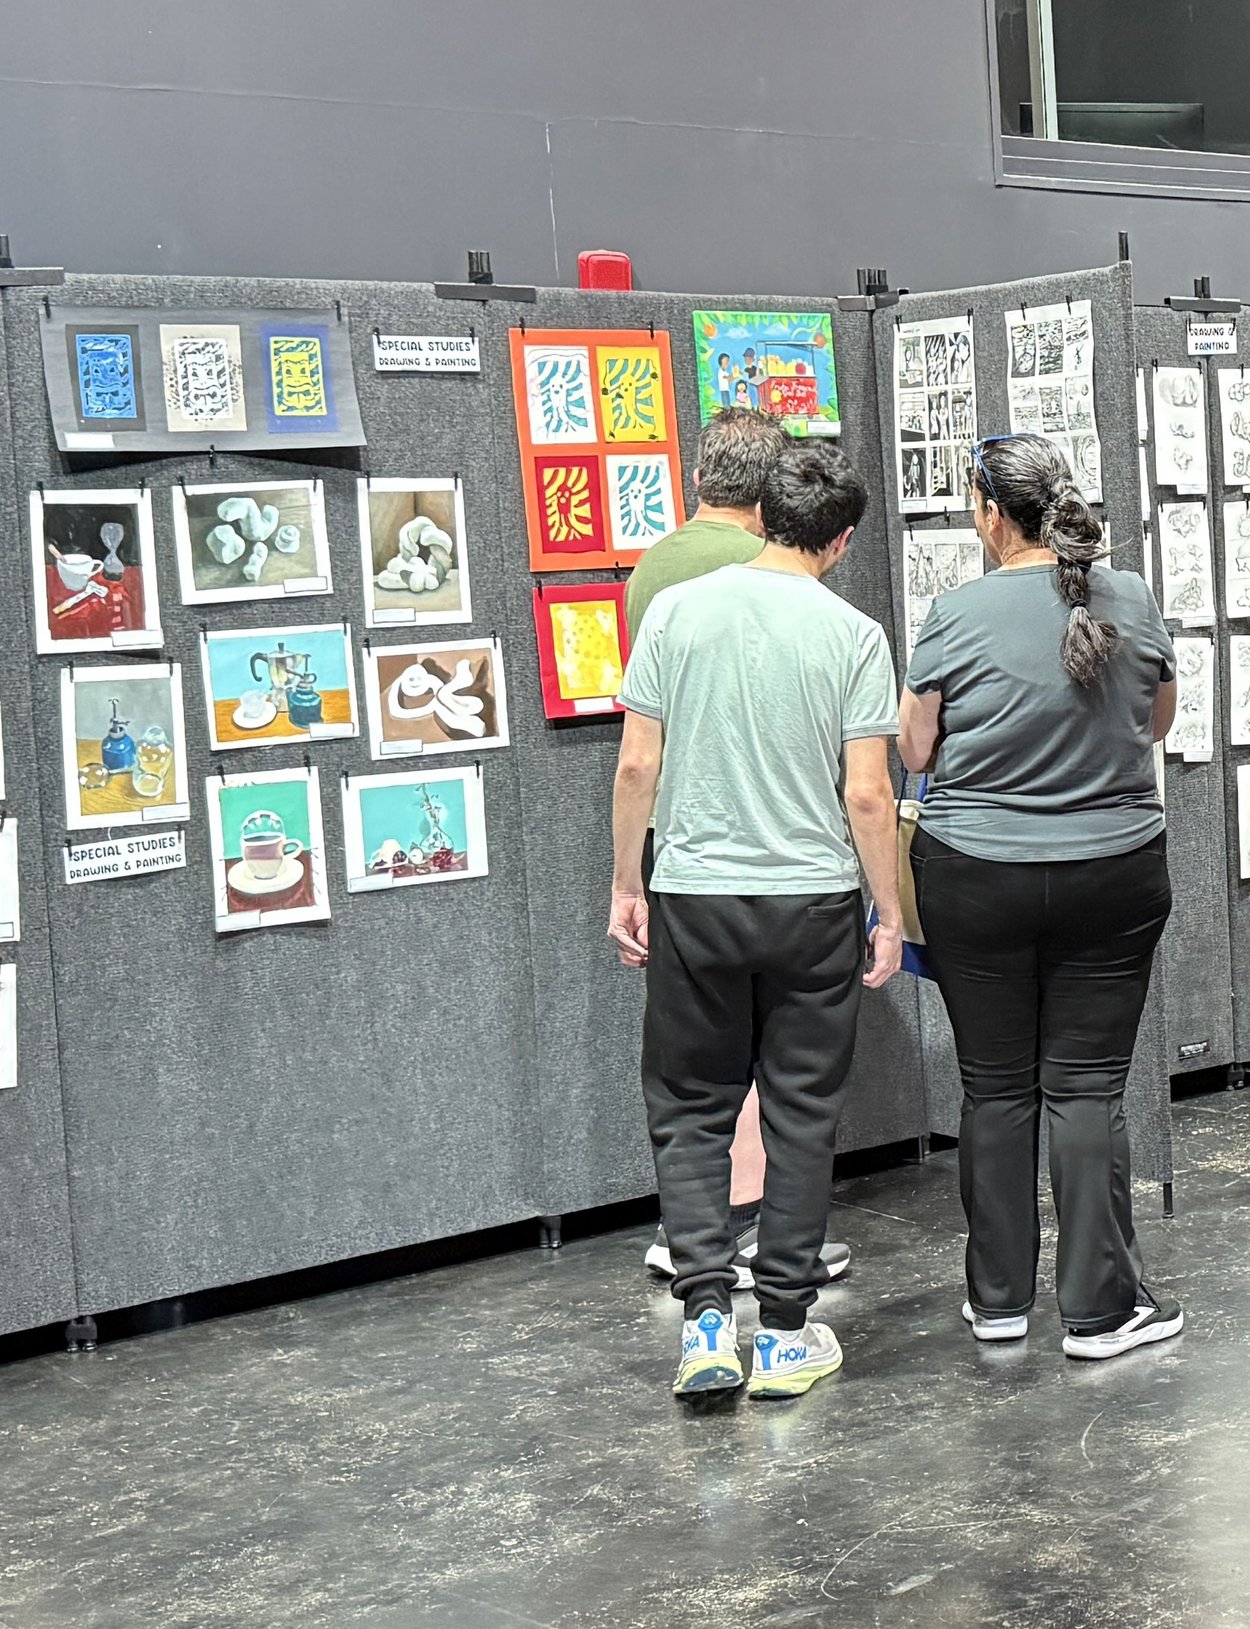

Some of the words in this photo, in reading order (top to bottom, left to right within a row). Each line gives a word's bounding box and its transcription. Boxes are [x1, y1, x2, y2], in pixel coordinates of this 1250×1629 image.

[381, 341, 423, 351] SPECIAL
[428, 341, 471, 351] STUDIES
[379, 357, 420, 366] DRAWING
[435, 358, 476, 366] PAINTING
[73, 845, 122, 861] SPECIAL
[128, 837, 176, 853] STUDIES
[70, 863, 119, 879] DRAWING
[124, 861, 131, 871] &
[136, 854, 182, 868] PAINTING
